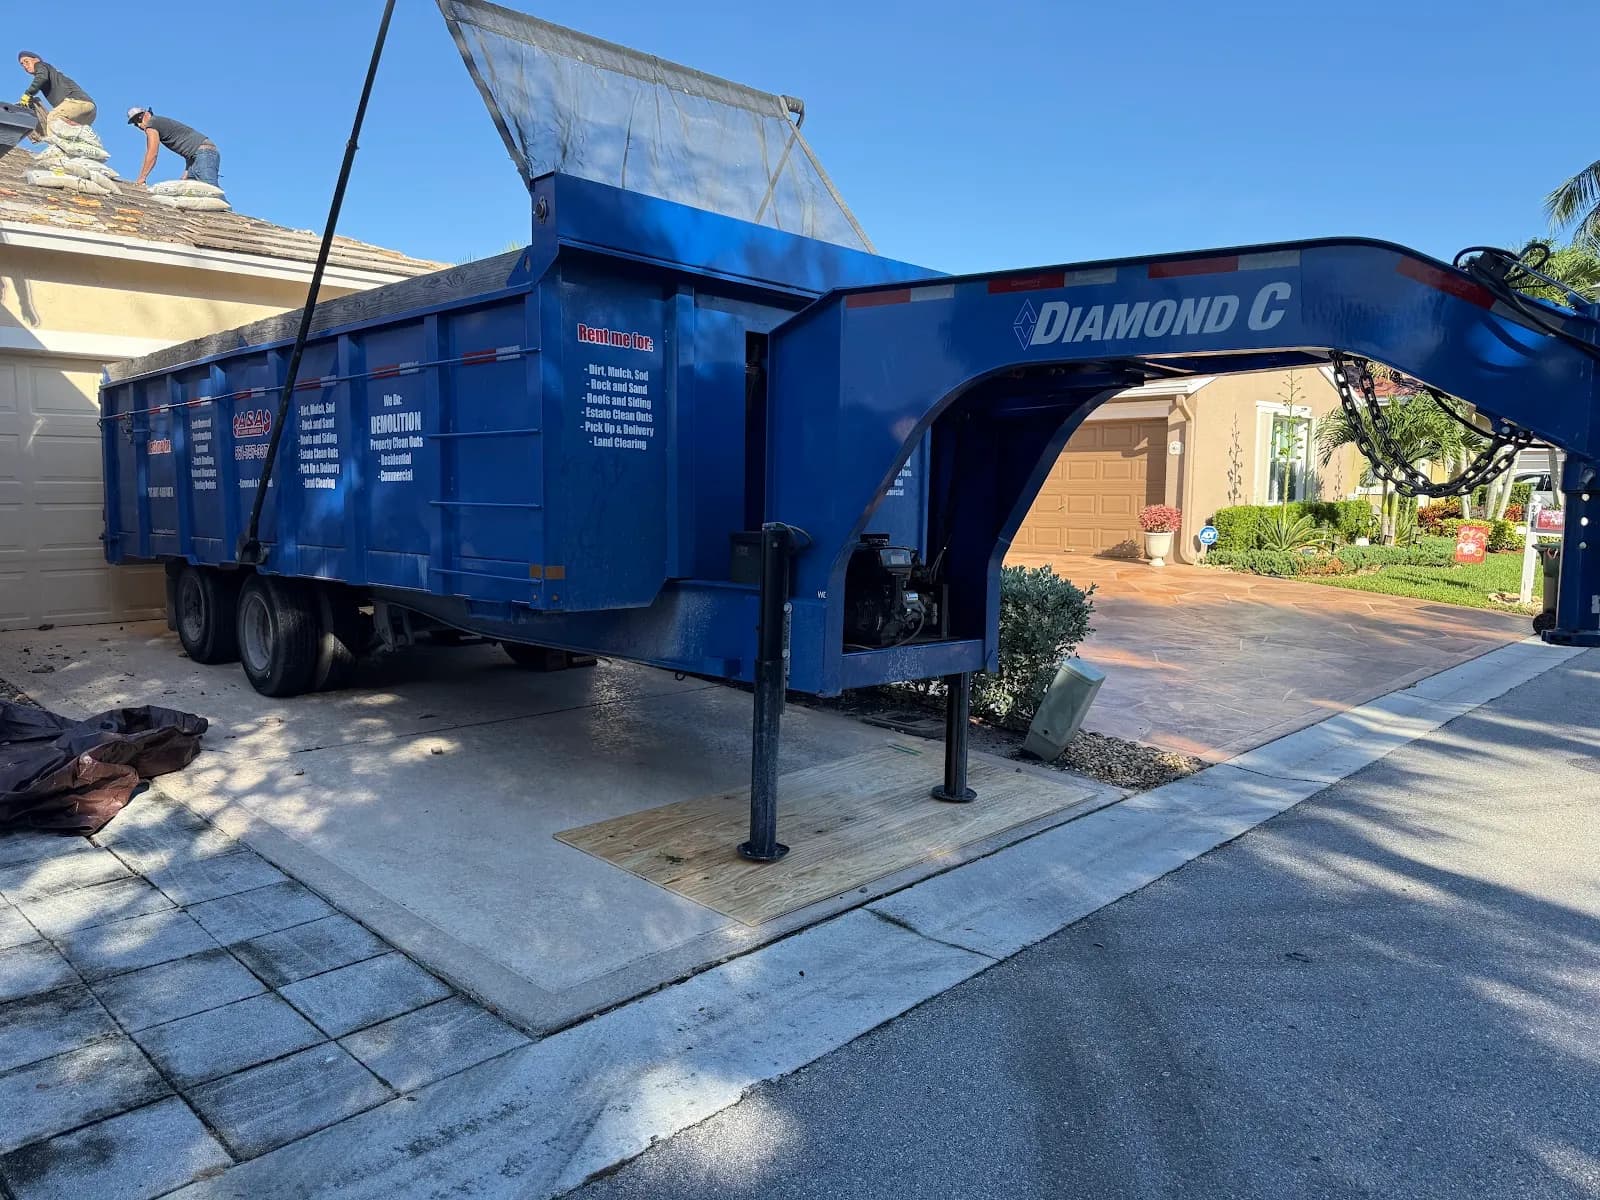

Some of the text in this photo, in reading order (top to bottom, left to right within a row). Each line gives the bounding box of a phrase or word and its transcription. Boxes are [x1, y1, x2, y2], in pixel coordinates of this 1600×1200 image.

[1030, 282, 1291, 345] DIAMOND C
[577, 323, 653, 352] Rent me for:
[589, 364, 606, 377] Dirt,
[608, 366, 634, 380] Mulch,
[634, 370, 649, 381] Sod
[591, 379, 611, 391] Rock
[612, 381, 628, 393] and
[628, 382, 648, 395] Sand
[383, 394, 393, 407] We
[586, 392, 611, 405] Roofs
[611, 395, 627, 407] and
[627, 396, 652, 410] Siding
[370, 411, 422, 435] DEMOLITION
[585, 407, 611, 420] Estate
[612, 409, 635, 421] Clean
[635, 411, 653, 423] Outs
[585, 421, 603, 433] Pick
[604, 422, 615, 435] Up
[623, 424, 654, 437] Delivery
[370, 435, 423, 451] Property Clean Outs
[594, 436, 613, 447] Land
[614, 436, 647, 450] Clearing
[381, 452, 412, 466] Residential
[380, 469, 413, 482] Commercial
